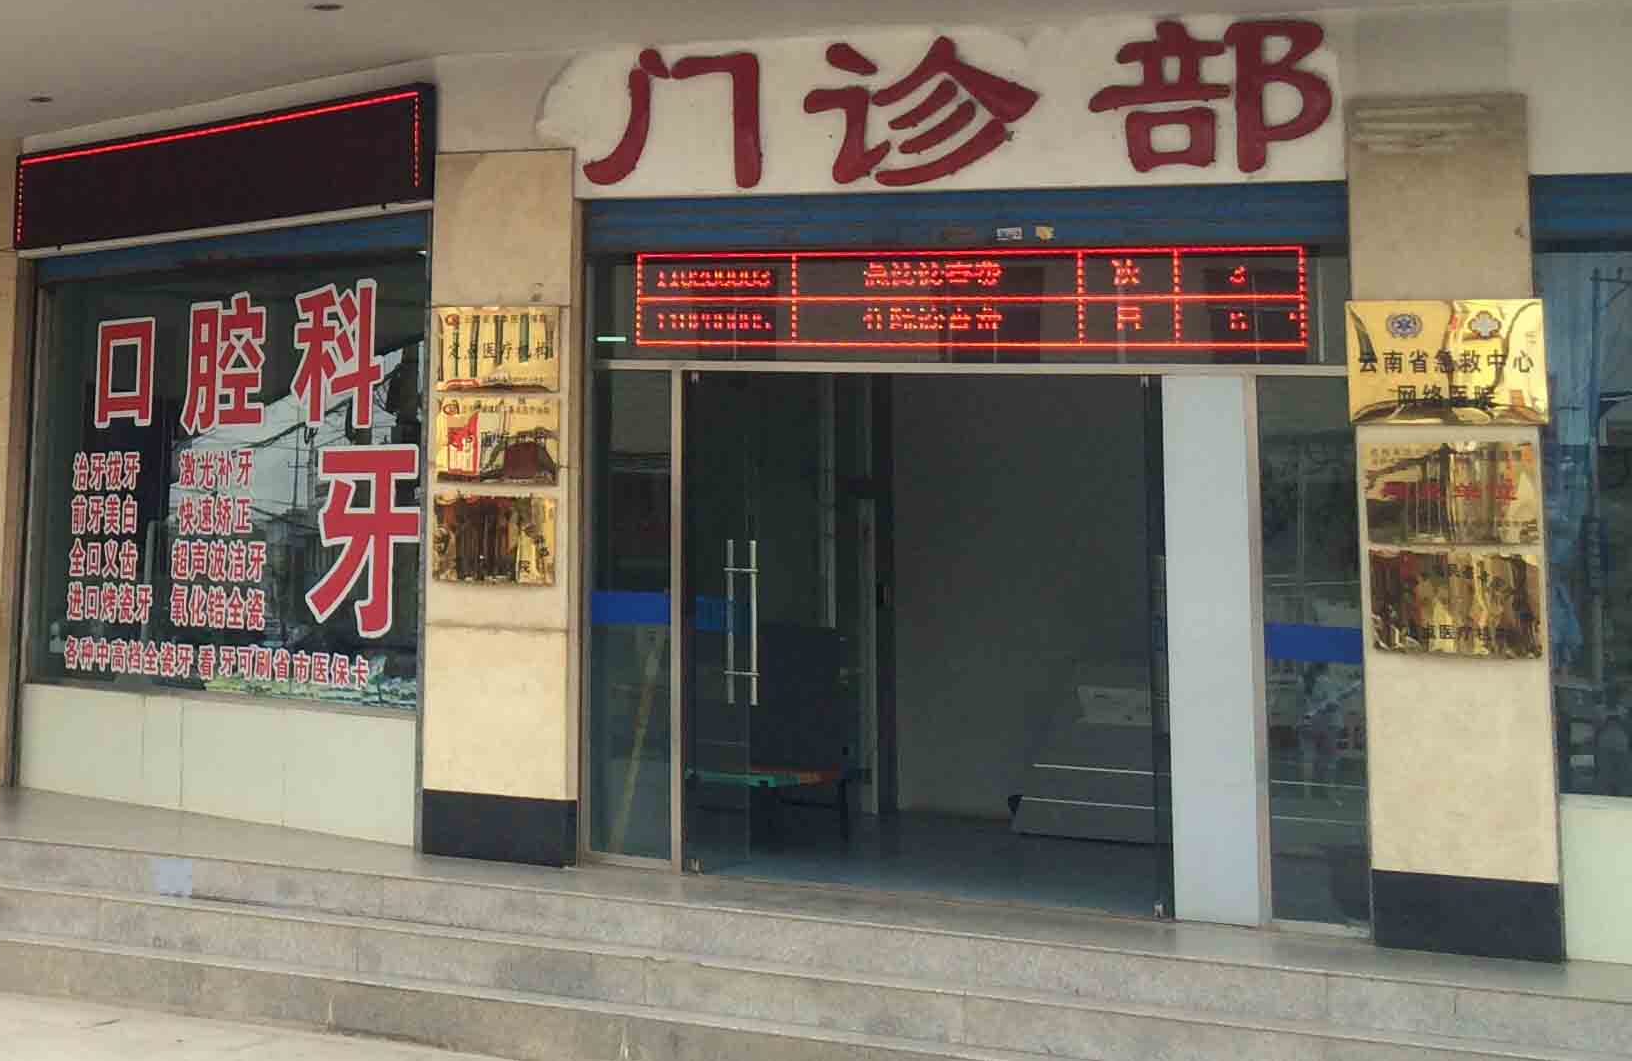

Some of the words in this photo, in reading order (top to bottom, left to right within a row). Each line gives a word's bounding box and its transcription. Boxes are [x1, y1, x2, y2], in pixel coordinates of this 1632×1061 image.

[582, 18, 1333, 189] 门诊部
[94, 278, 384, 435] 口腔科
[1358, 348, 1536, 374] 云南省急救中心
[72, 451, 141, 492] 治牙拔牙
[178, 449, 255, 489] 激光补牙
[71, 495, 139, 536] 前牙美白
[178, 495, 254, 536] 快速矫正
[69, 539, 138, 580] 全口义齿
[171, 540, 267, 582] 超声波洁牙
[305, 444, 421, 640] 牙
[66, 583, 153, 624] 进口烤瓷牙
[169, 585, 267, 631] 氧化锆全瓷
